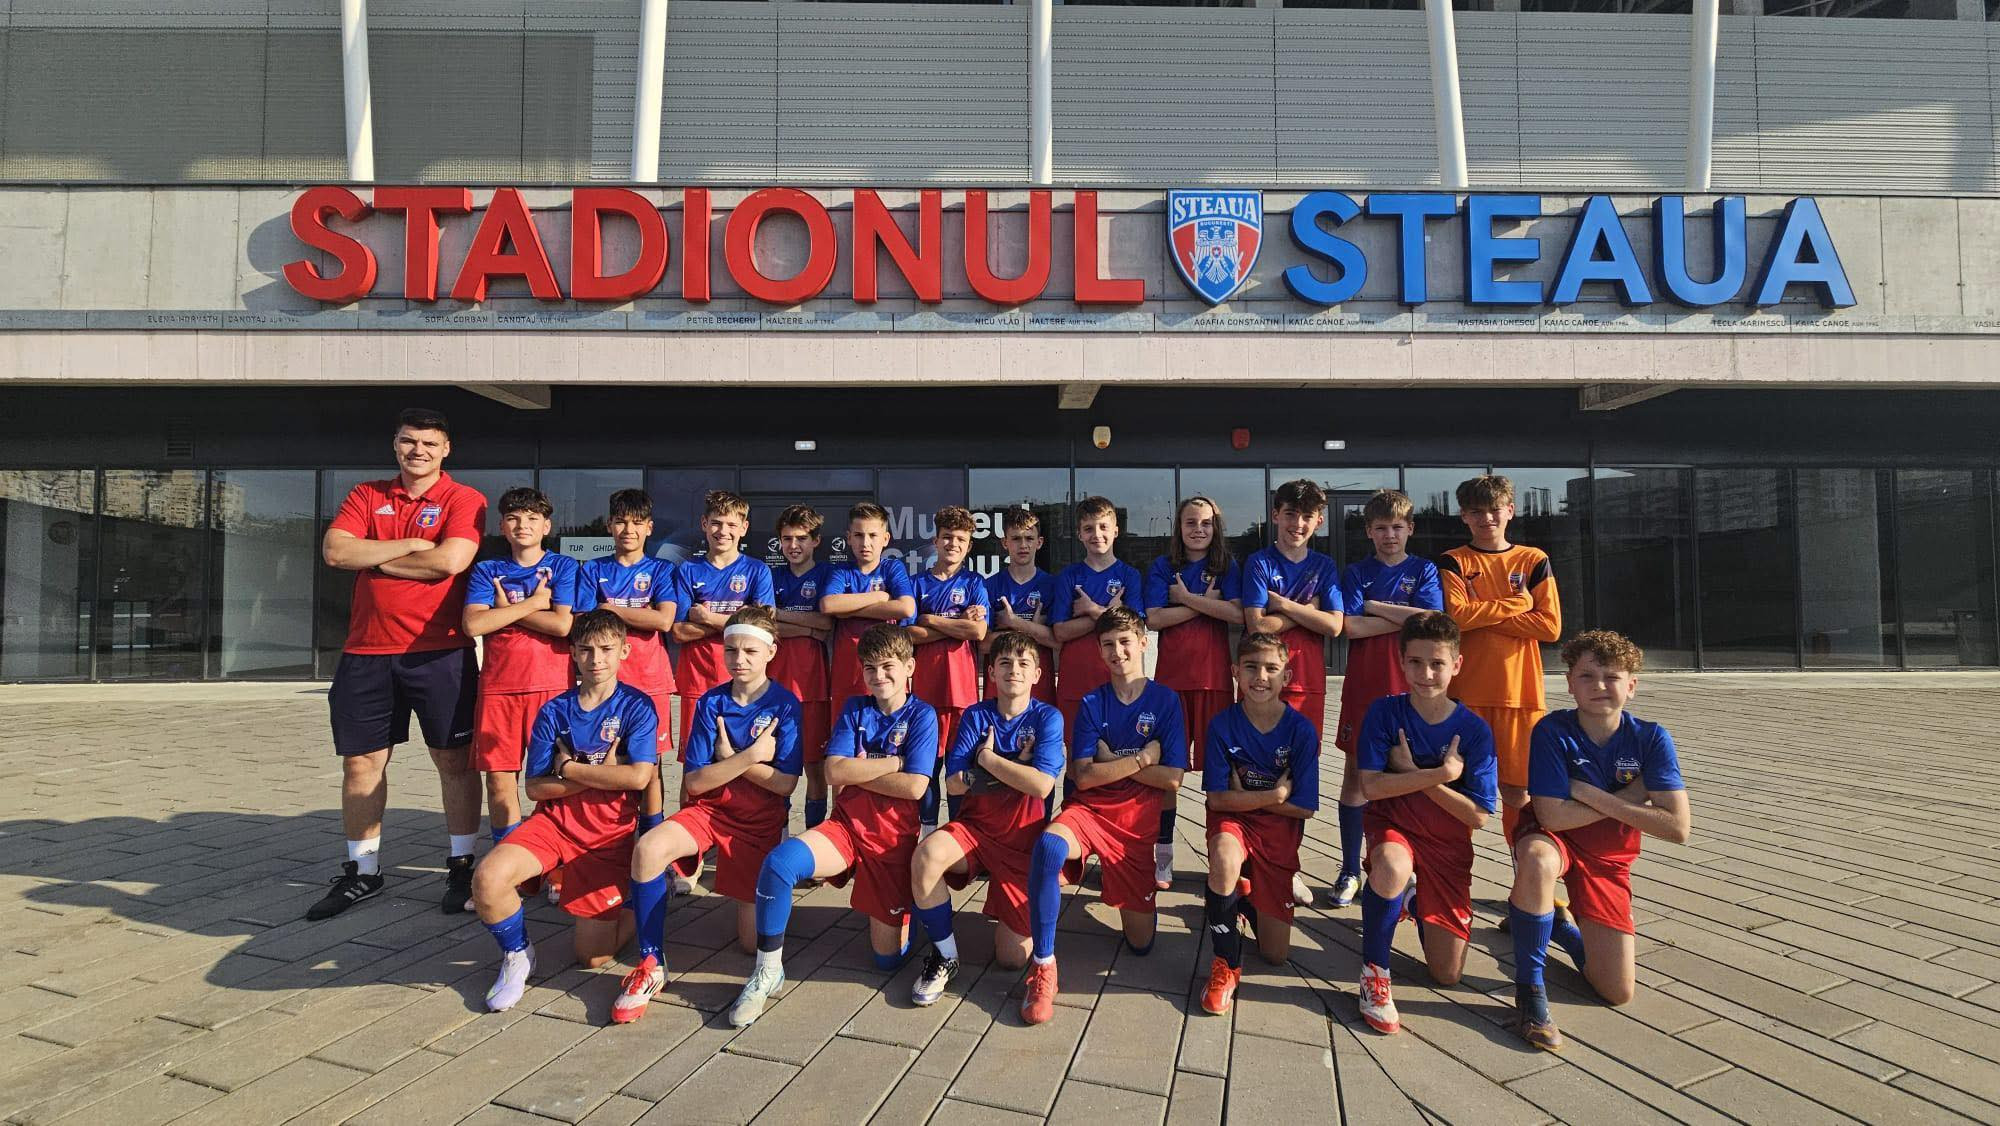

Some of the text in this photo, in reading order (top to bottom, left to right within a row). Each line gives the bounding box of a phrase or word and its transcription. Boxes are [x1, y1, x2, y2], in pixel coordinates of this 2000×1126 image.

[1174, 196, 1258, 224] STEAUA
[281, 187, 1146, 304] STADIONUL
[1282, 190, 1857, 309] STEAUA
[148, 315, 175, 323] ELENA
[1194, 318, 1225, 326] AGAFIA
[1227, 318, 1279, 326] CONSTANTIN
[1288, 318, 1314, 326] KAIAC
[1316, 318, 1344, 326] CANOE
[569, 544, 584, 552] TUR
